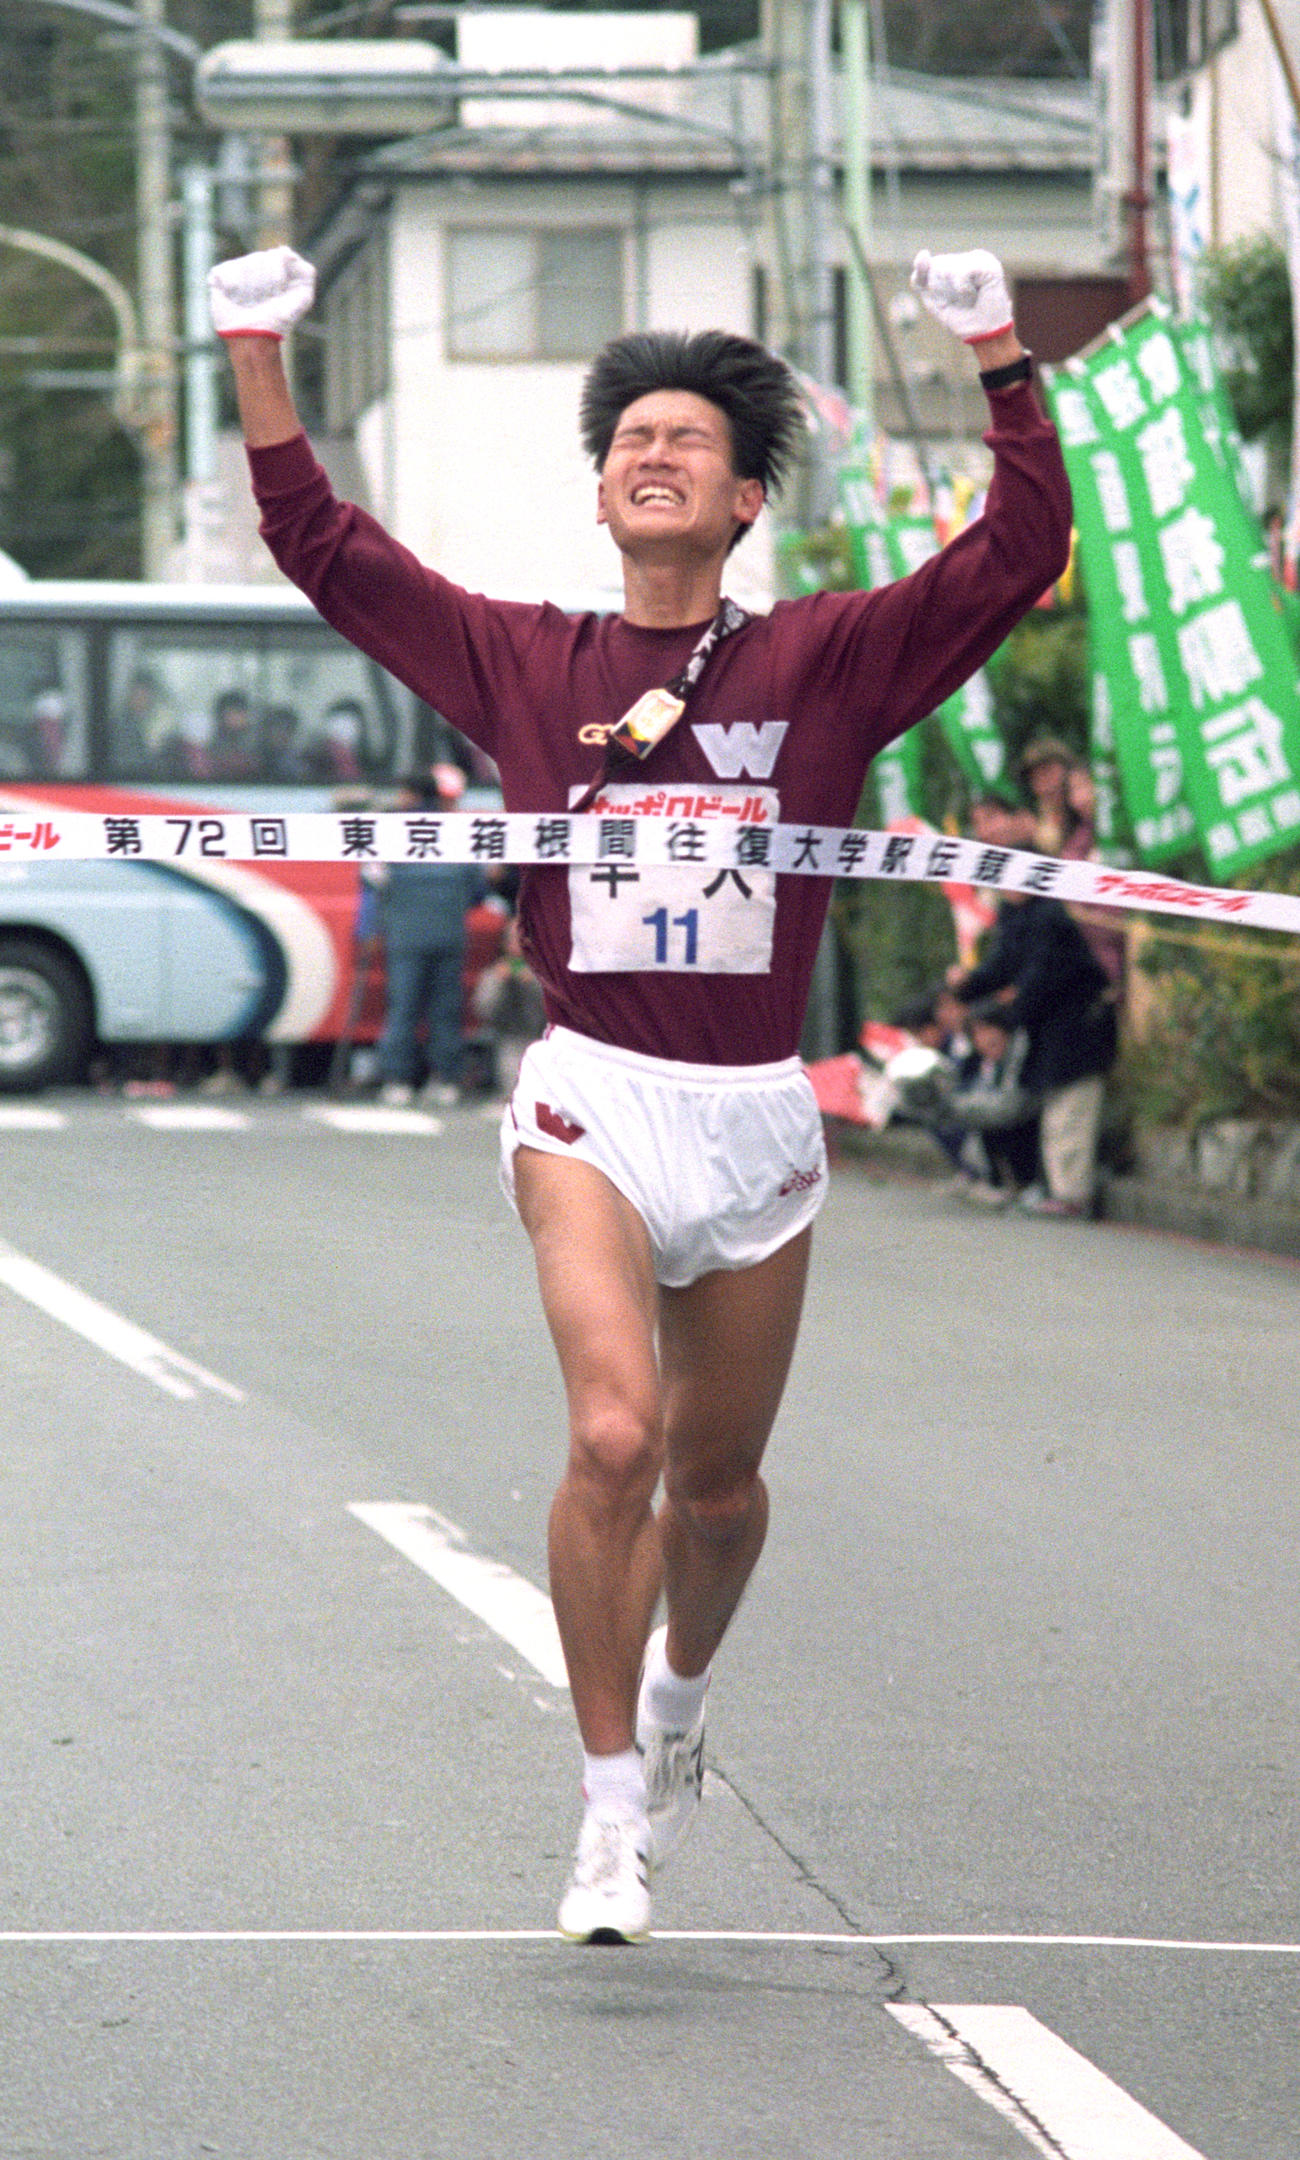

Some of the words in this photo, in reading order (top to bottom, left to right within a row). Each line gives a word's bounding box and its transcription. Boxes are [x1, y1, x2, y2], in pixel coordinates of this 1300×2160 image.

[691, 721, 788, 778] W
[103, 817, 289, 857] 第72回
[642, 907, 698, 965] 11
